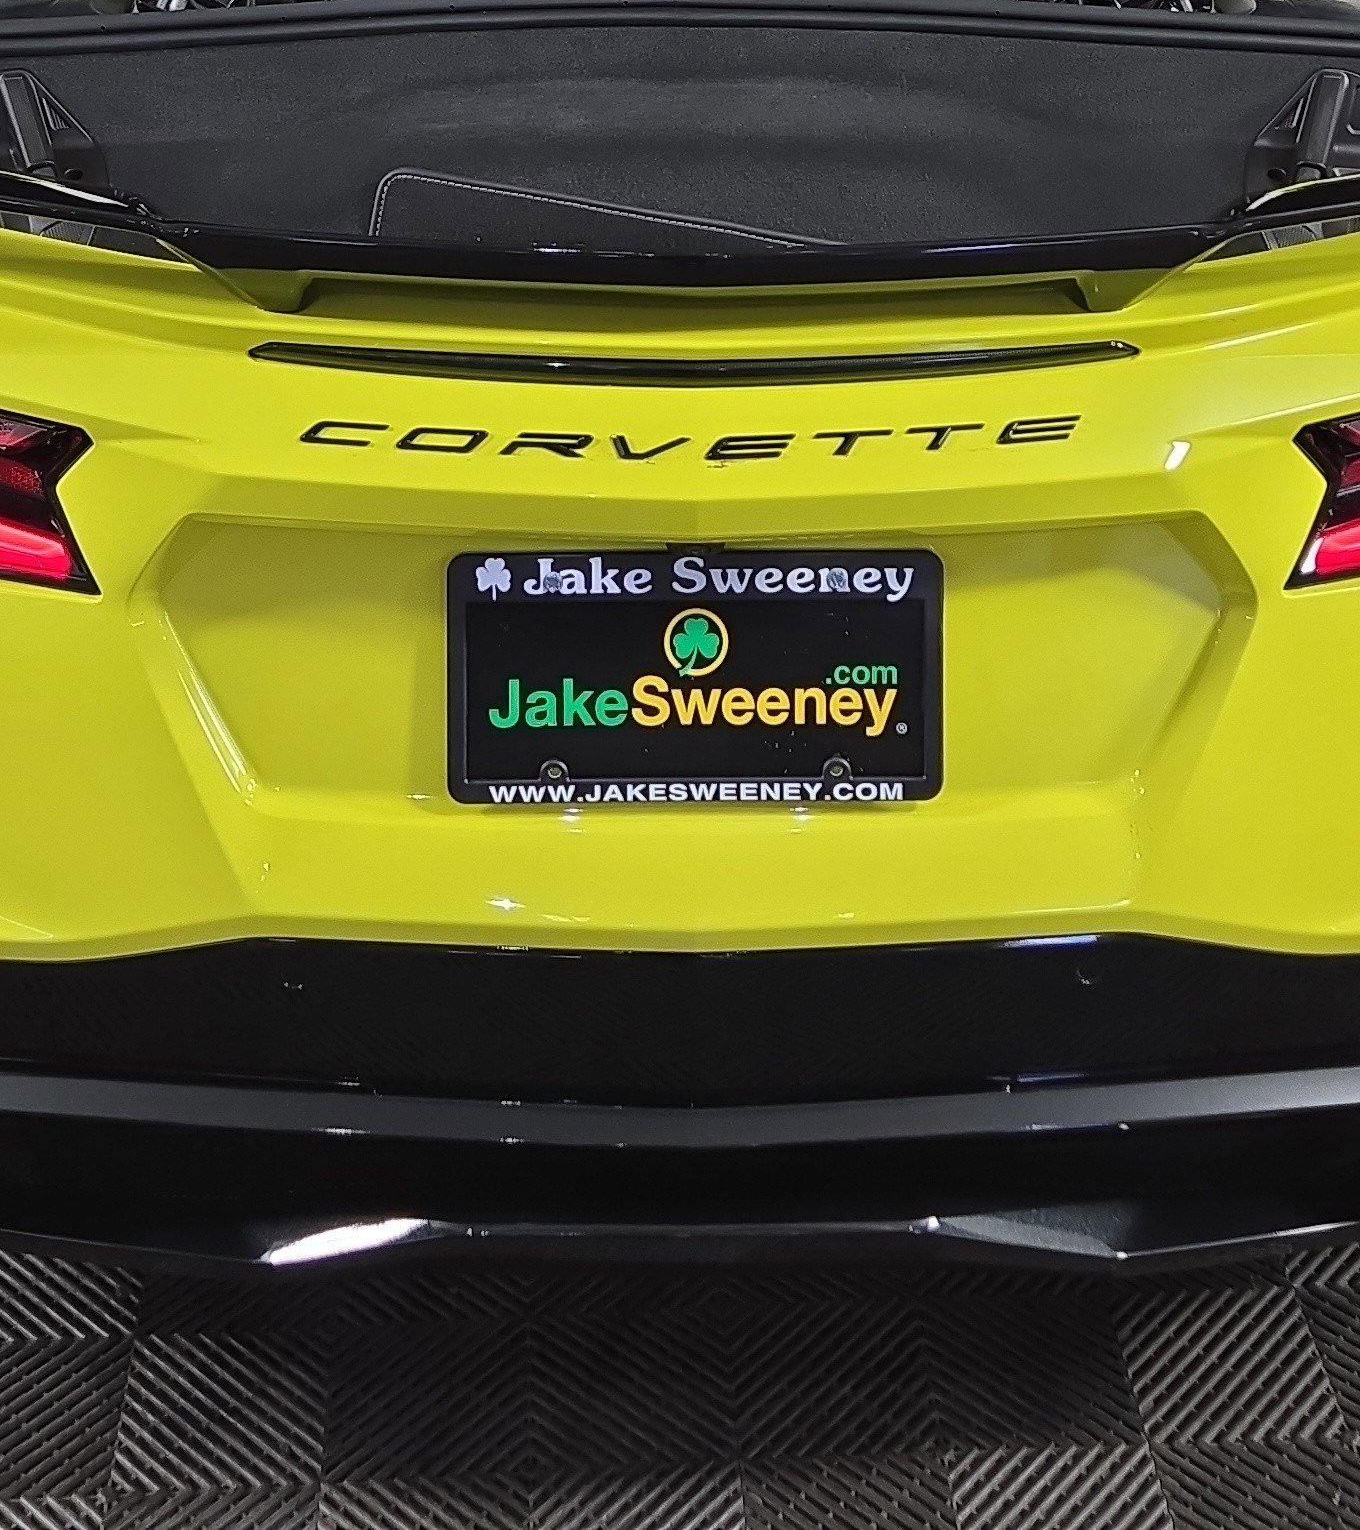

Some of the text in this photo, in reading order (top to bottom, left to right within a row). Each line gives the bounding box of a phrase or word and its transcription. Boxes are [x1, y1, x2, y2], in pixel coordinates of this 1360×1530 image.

[299, 414, 1083, 460] CORVETTE
[524, 557, 915, 602] Jake Sweeney
[825, 664, 898, 685] .com
[489, 783, 904, 803] WWW.JAKESWEENEY.COM
